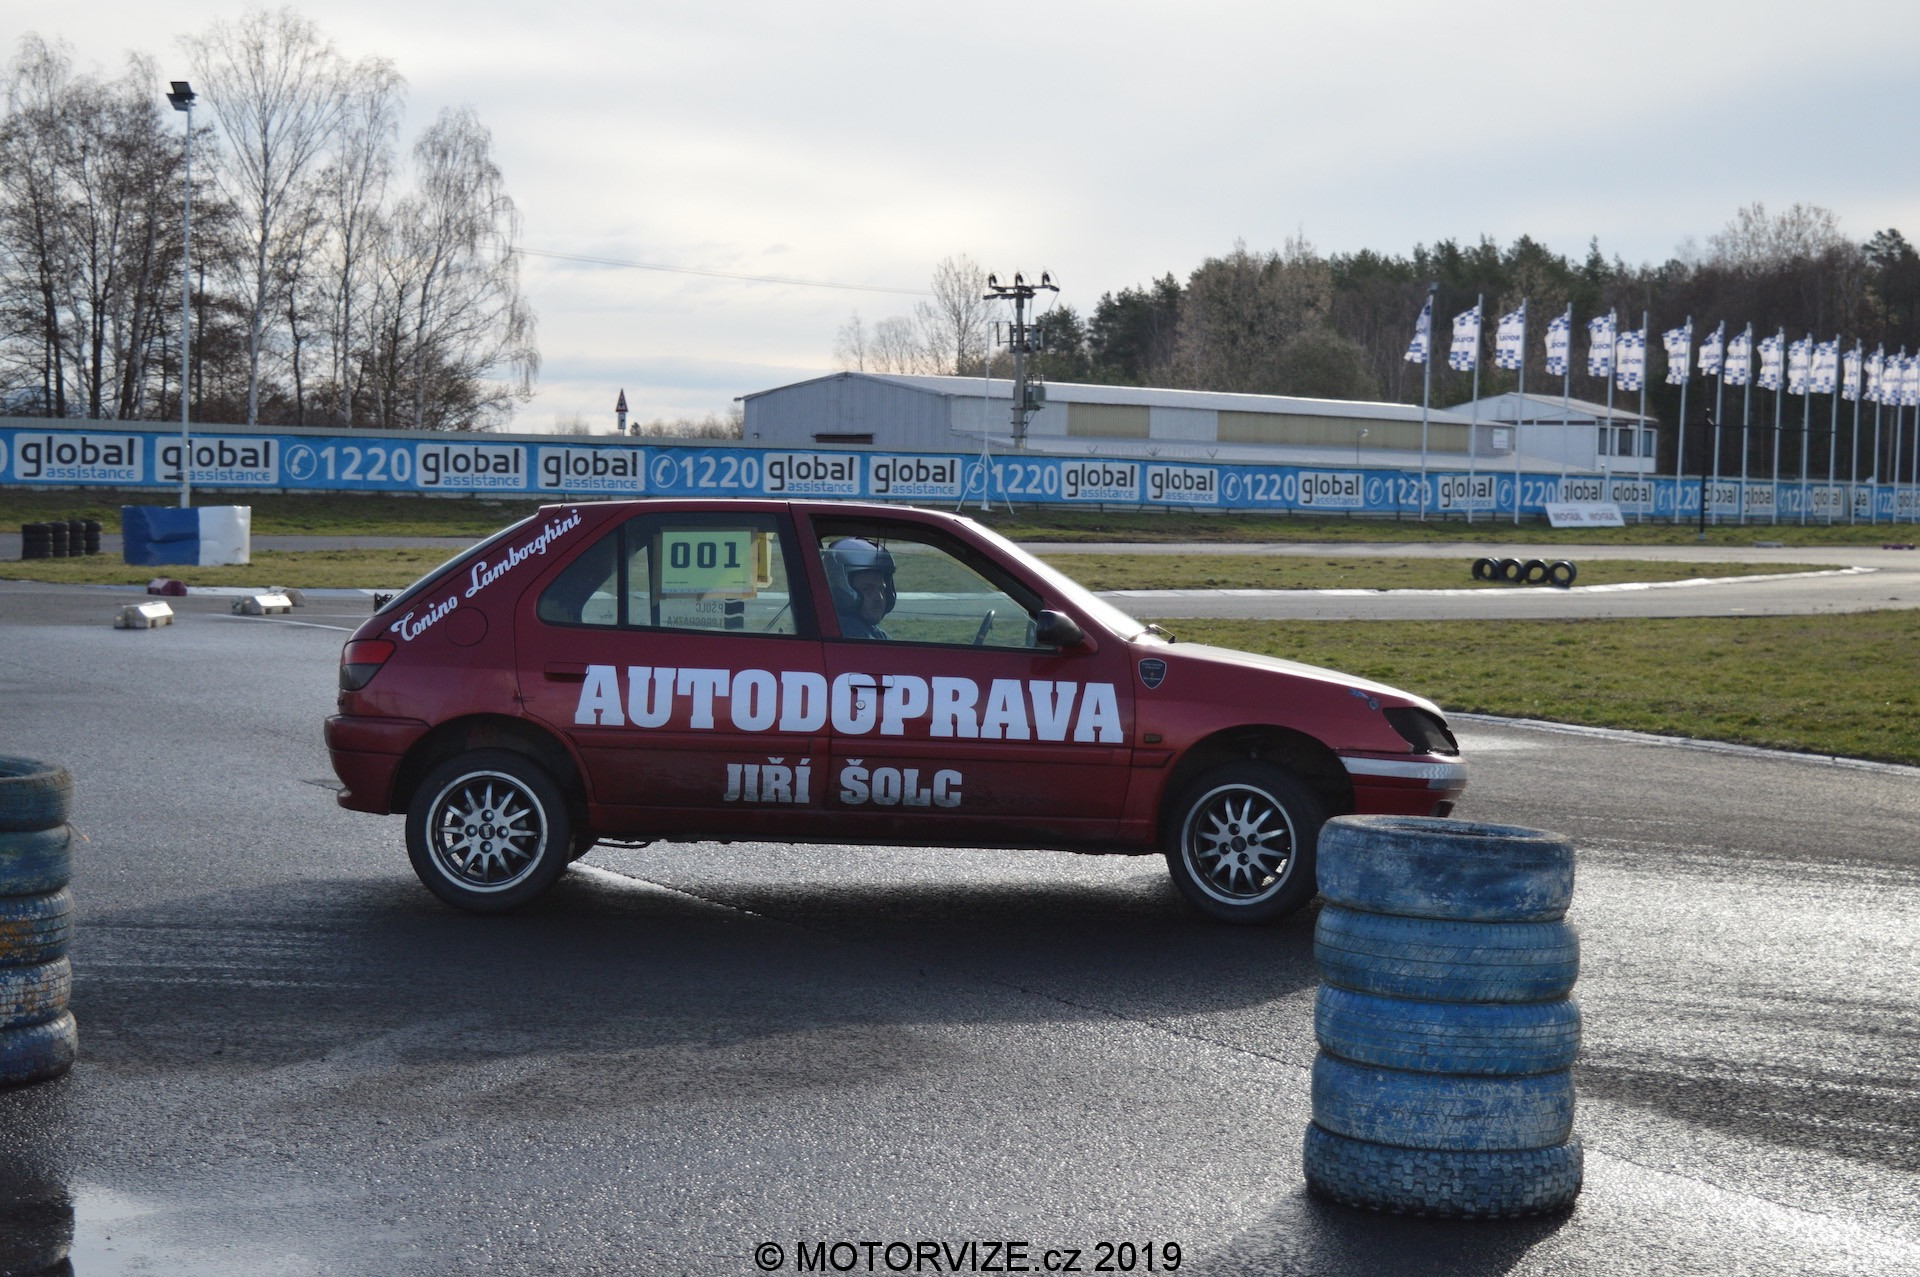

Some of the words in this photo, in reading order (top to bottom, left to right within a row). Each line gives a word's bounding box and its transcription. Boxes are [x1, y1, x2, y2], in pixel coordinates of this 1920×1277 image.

[21, 436, 135, 477] global
[162, 439, 270, 480] global
[320, 446, 411, 481] 1220
[422, 446, 519, 485] global
[544, 449, 637, 487] global
[46, 466, 134, 479] assistance
[187, 468, 271, 480] assistance
[443, 474, 519, 486] assistance
[564, 477, 637, 489] assistance
[680, 456, 759, 489] 1220
[768, 455, 854, 491] global
[787, 481, 853, 493] assistance
[874, 458, 955, 493] global
[991, 464, 1059, 495] 1220
[1066, 464, 1135, 497] global
[1151, 468, 1213, 499] global
[1243, 474, 1296, 501] 1220
[892, 483, 955, 495] assistance
[1081, 487, 1134, 499] assistance
[1165, 491, 1213, 502] assistance
[1302, 474, 1360, 504] global
[1385, 478, 1433, 505] 1220
[1441, 477, 1493, 507] global
[670, 542, 741, 568] 001
[391, 596, 458, 641] Tonino
[465, 509, 582, 598] Lamborghini
[575, 665, 1124, 743] AUTODOPRAVA
[723, 757, 811, 804] JIŘÍ
[840, 759, 963, 807] ŠOLC
